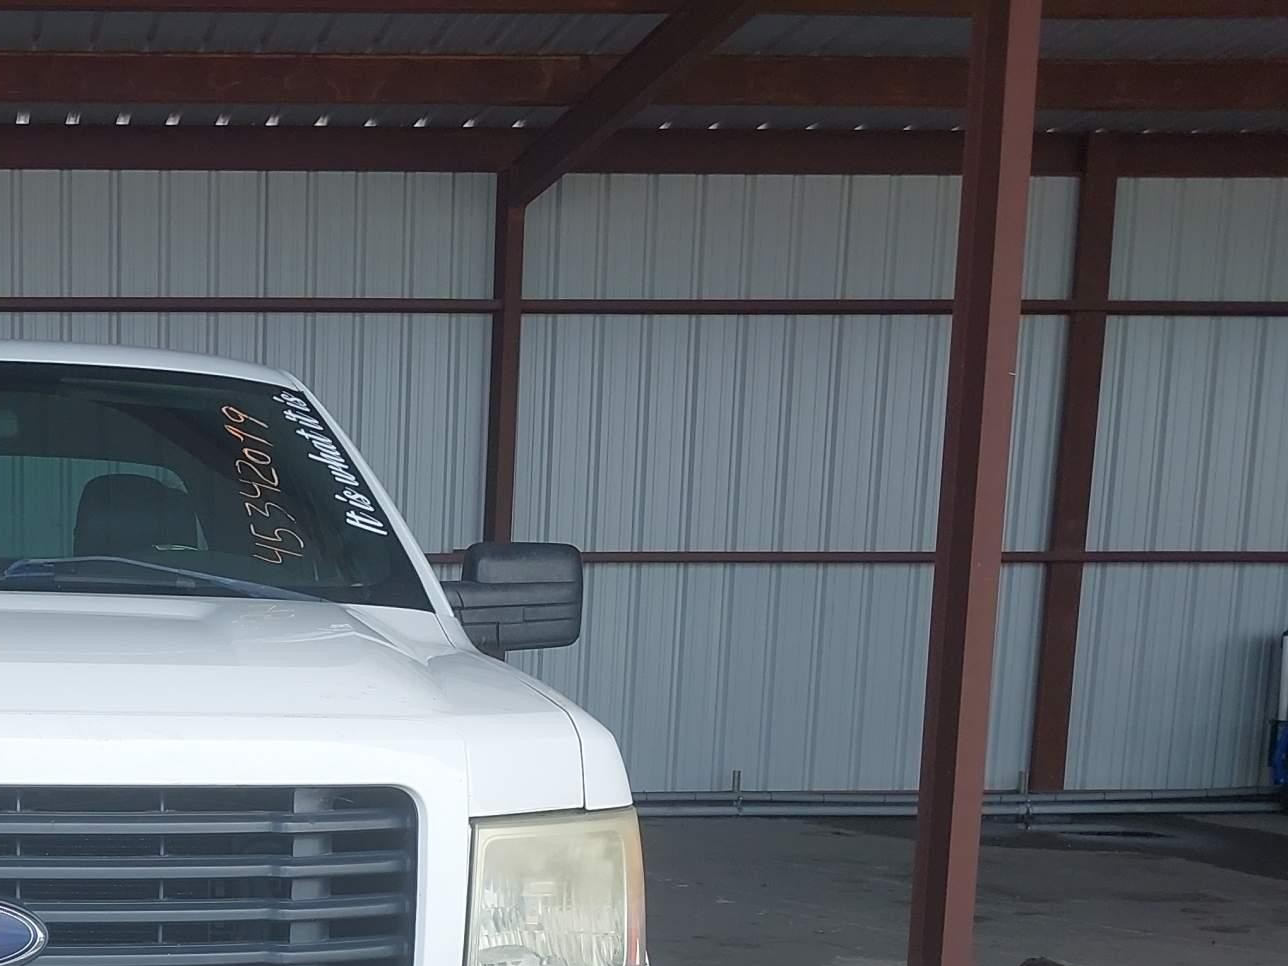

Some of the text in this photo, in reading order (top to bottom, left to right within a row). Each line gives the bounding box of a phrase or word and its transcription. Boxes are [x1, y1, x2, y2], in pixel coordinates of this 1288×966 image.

[221, 405, 305, 564] 45342019
[273, 391, 388, 536] It is what it is
